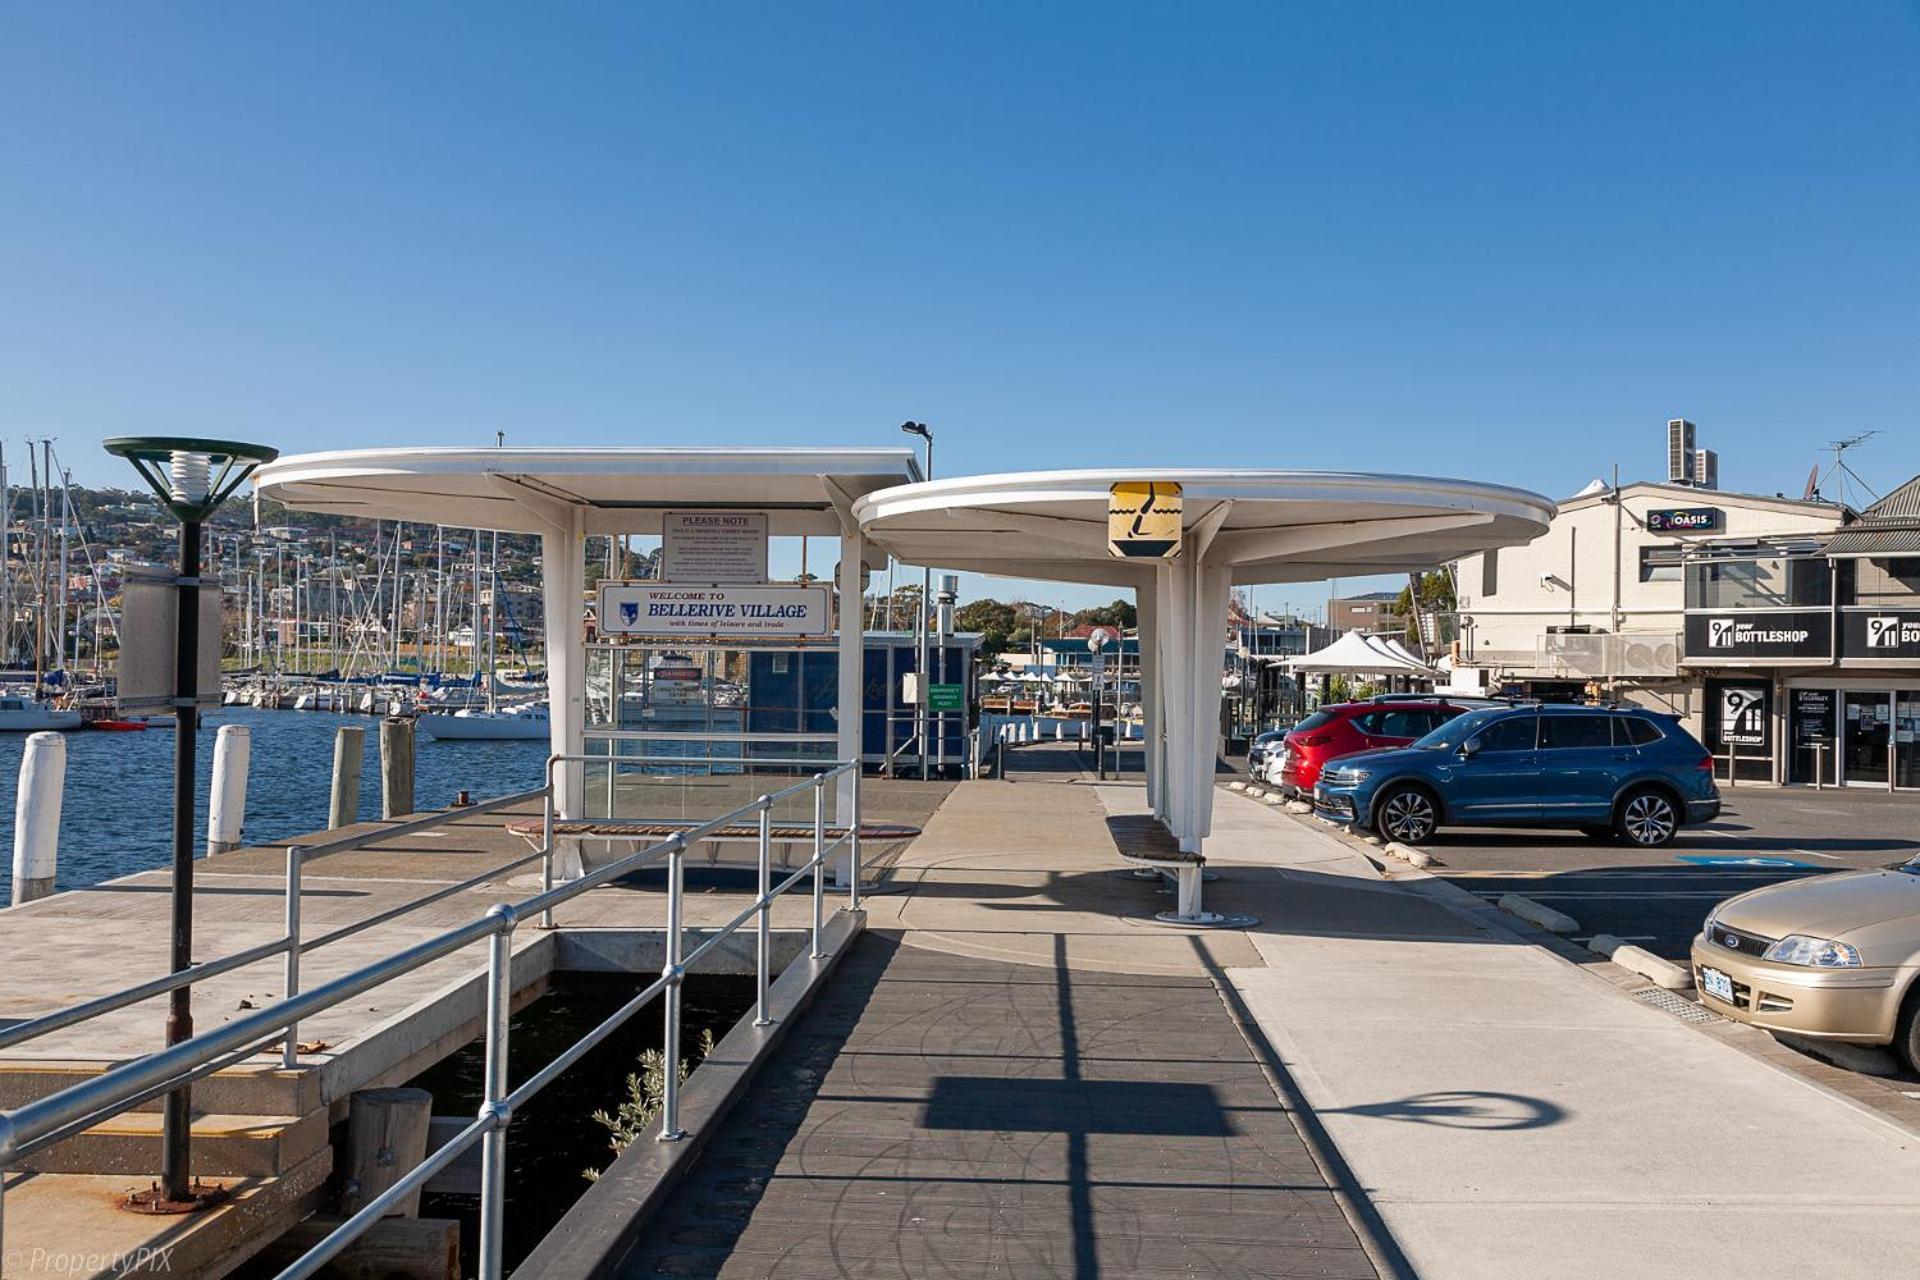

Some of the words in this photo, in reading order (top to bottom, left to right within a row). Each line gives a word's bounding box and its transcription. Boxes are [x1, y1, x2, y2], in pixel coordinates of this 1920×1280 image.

[682, 516, 720, 526] PLEASE
[722, 516, 748, 526] NOTE
[1674, 515, 1707, 525] OASIS
[648, 592, 705, 601] WELCOME
[708, 592, 725, 601] TO
[648, 603, 736, 618] BELLERIVE
[740, 604, 807, 619] VILLAGE
[669, 620, 686, 628] with
[688, 620, 708, 628] times
[710, 620, 719, 629] of
[719, 620, 745, 628] leisure
[747, 620, 762, 628] and
[764, 620, 785, 628] trade
[1735, 623, 1753, 631] your
[1735, 630, 1809, 643] BOTTLESHOP
[1724, 735, 1762, 743] BOTTLESHOP
